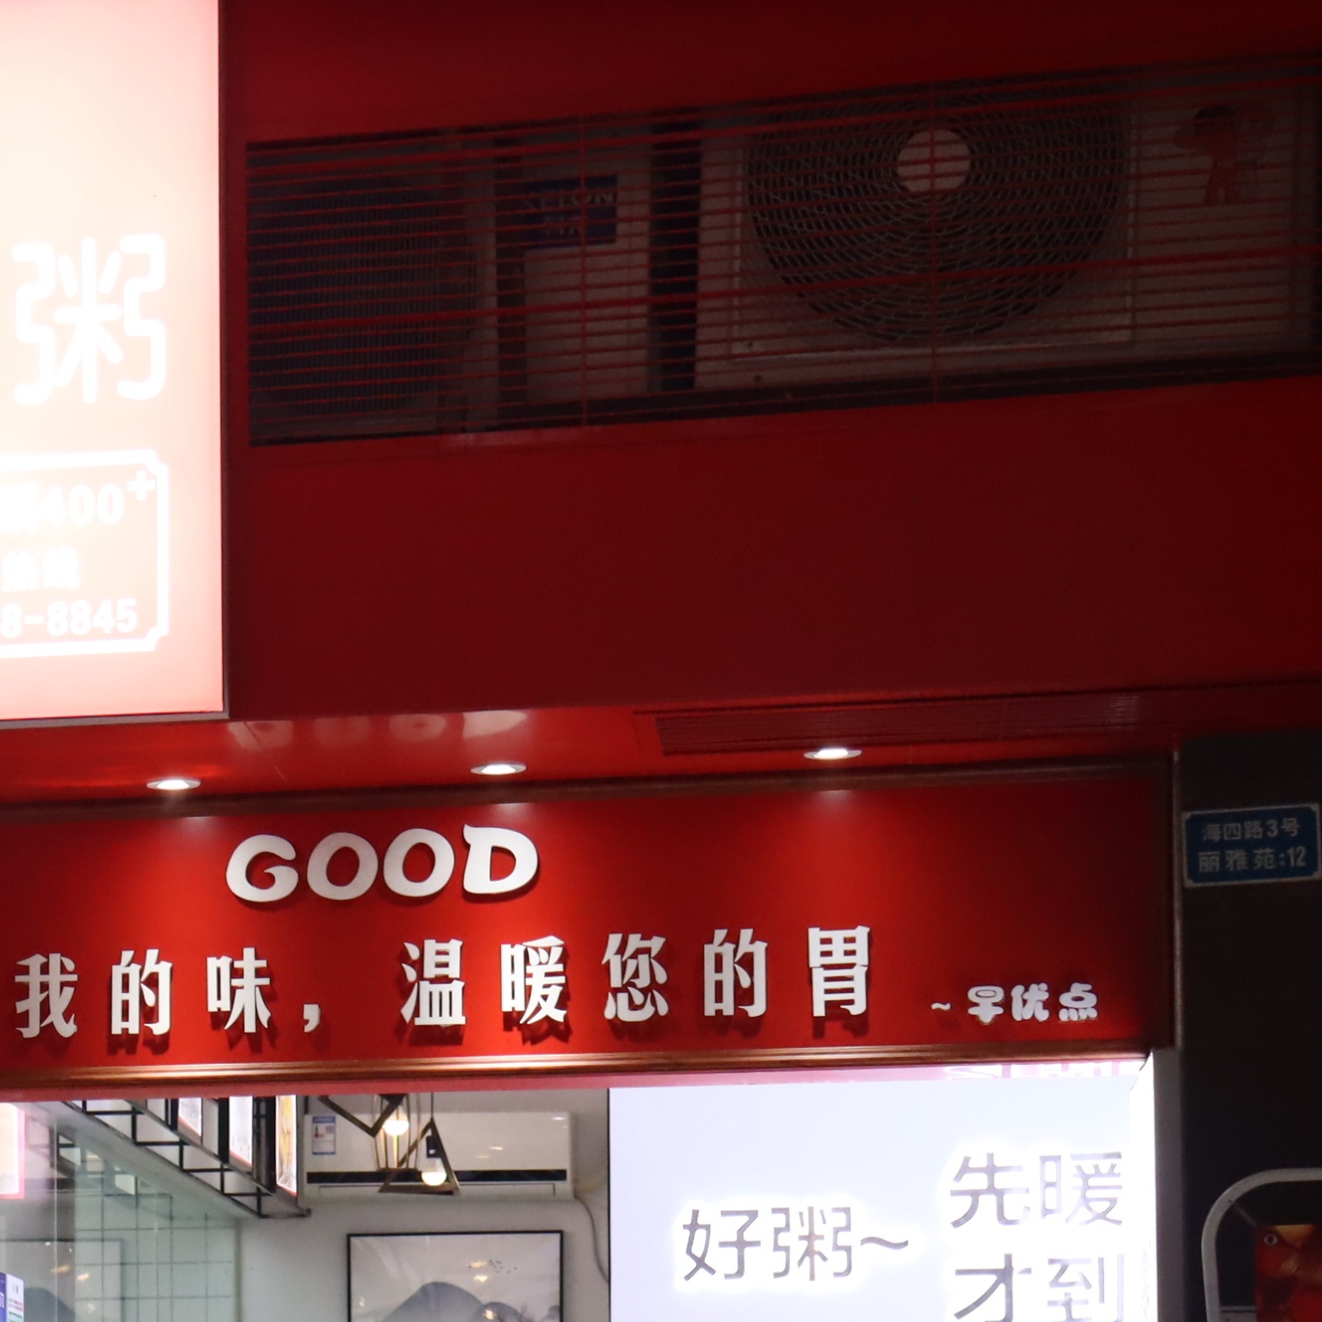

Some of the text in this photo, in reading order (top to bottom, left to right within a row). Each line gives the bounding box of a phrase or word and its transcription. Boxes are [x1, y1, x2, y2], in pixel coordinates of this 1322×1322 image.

[13, 235, 167, 404] 粥
[226, 825, 539, 903] GOOD
[1202, 817, 1301, 843] 海四路3号
[949, 1151, 1124, 1230] 先暖
